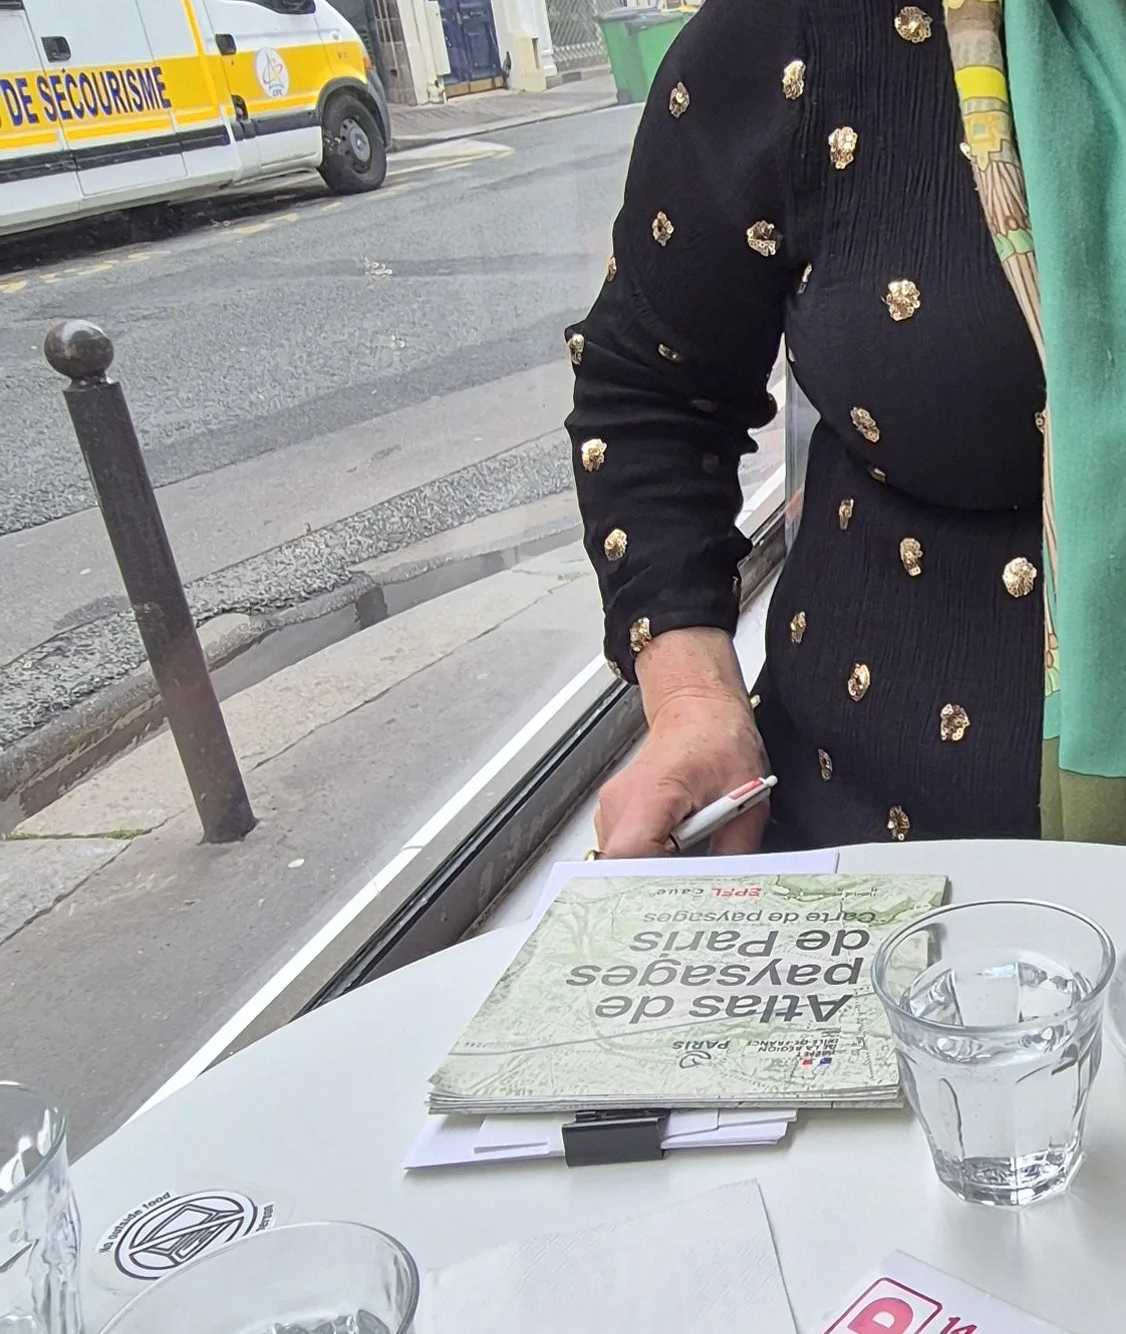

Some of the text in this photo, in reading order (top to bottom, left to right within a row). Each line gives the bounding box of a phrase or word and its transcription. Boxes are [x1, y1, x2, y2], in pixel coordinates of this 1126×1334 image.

[0, 66, 172, 125] DE SECOURISME
[643, 909, 876, 925] Carte de paysages
[630, 929, 870, 957] de Paris
[566, 957, 864, 987] paysages
[595, 994, 853, 1025] Atlas de
[672, 1040, 731, 1050] PARIS
